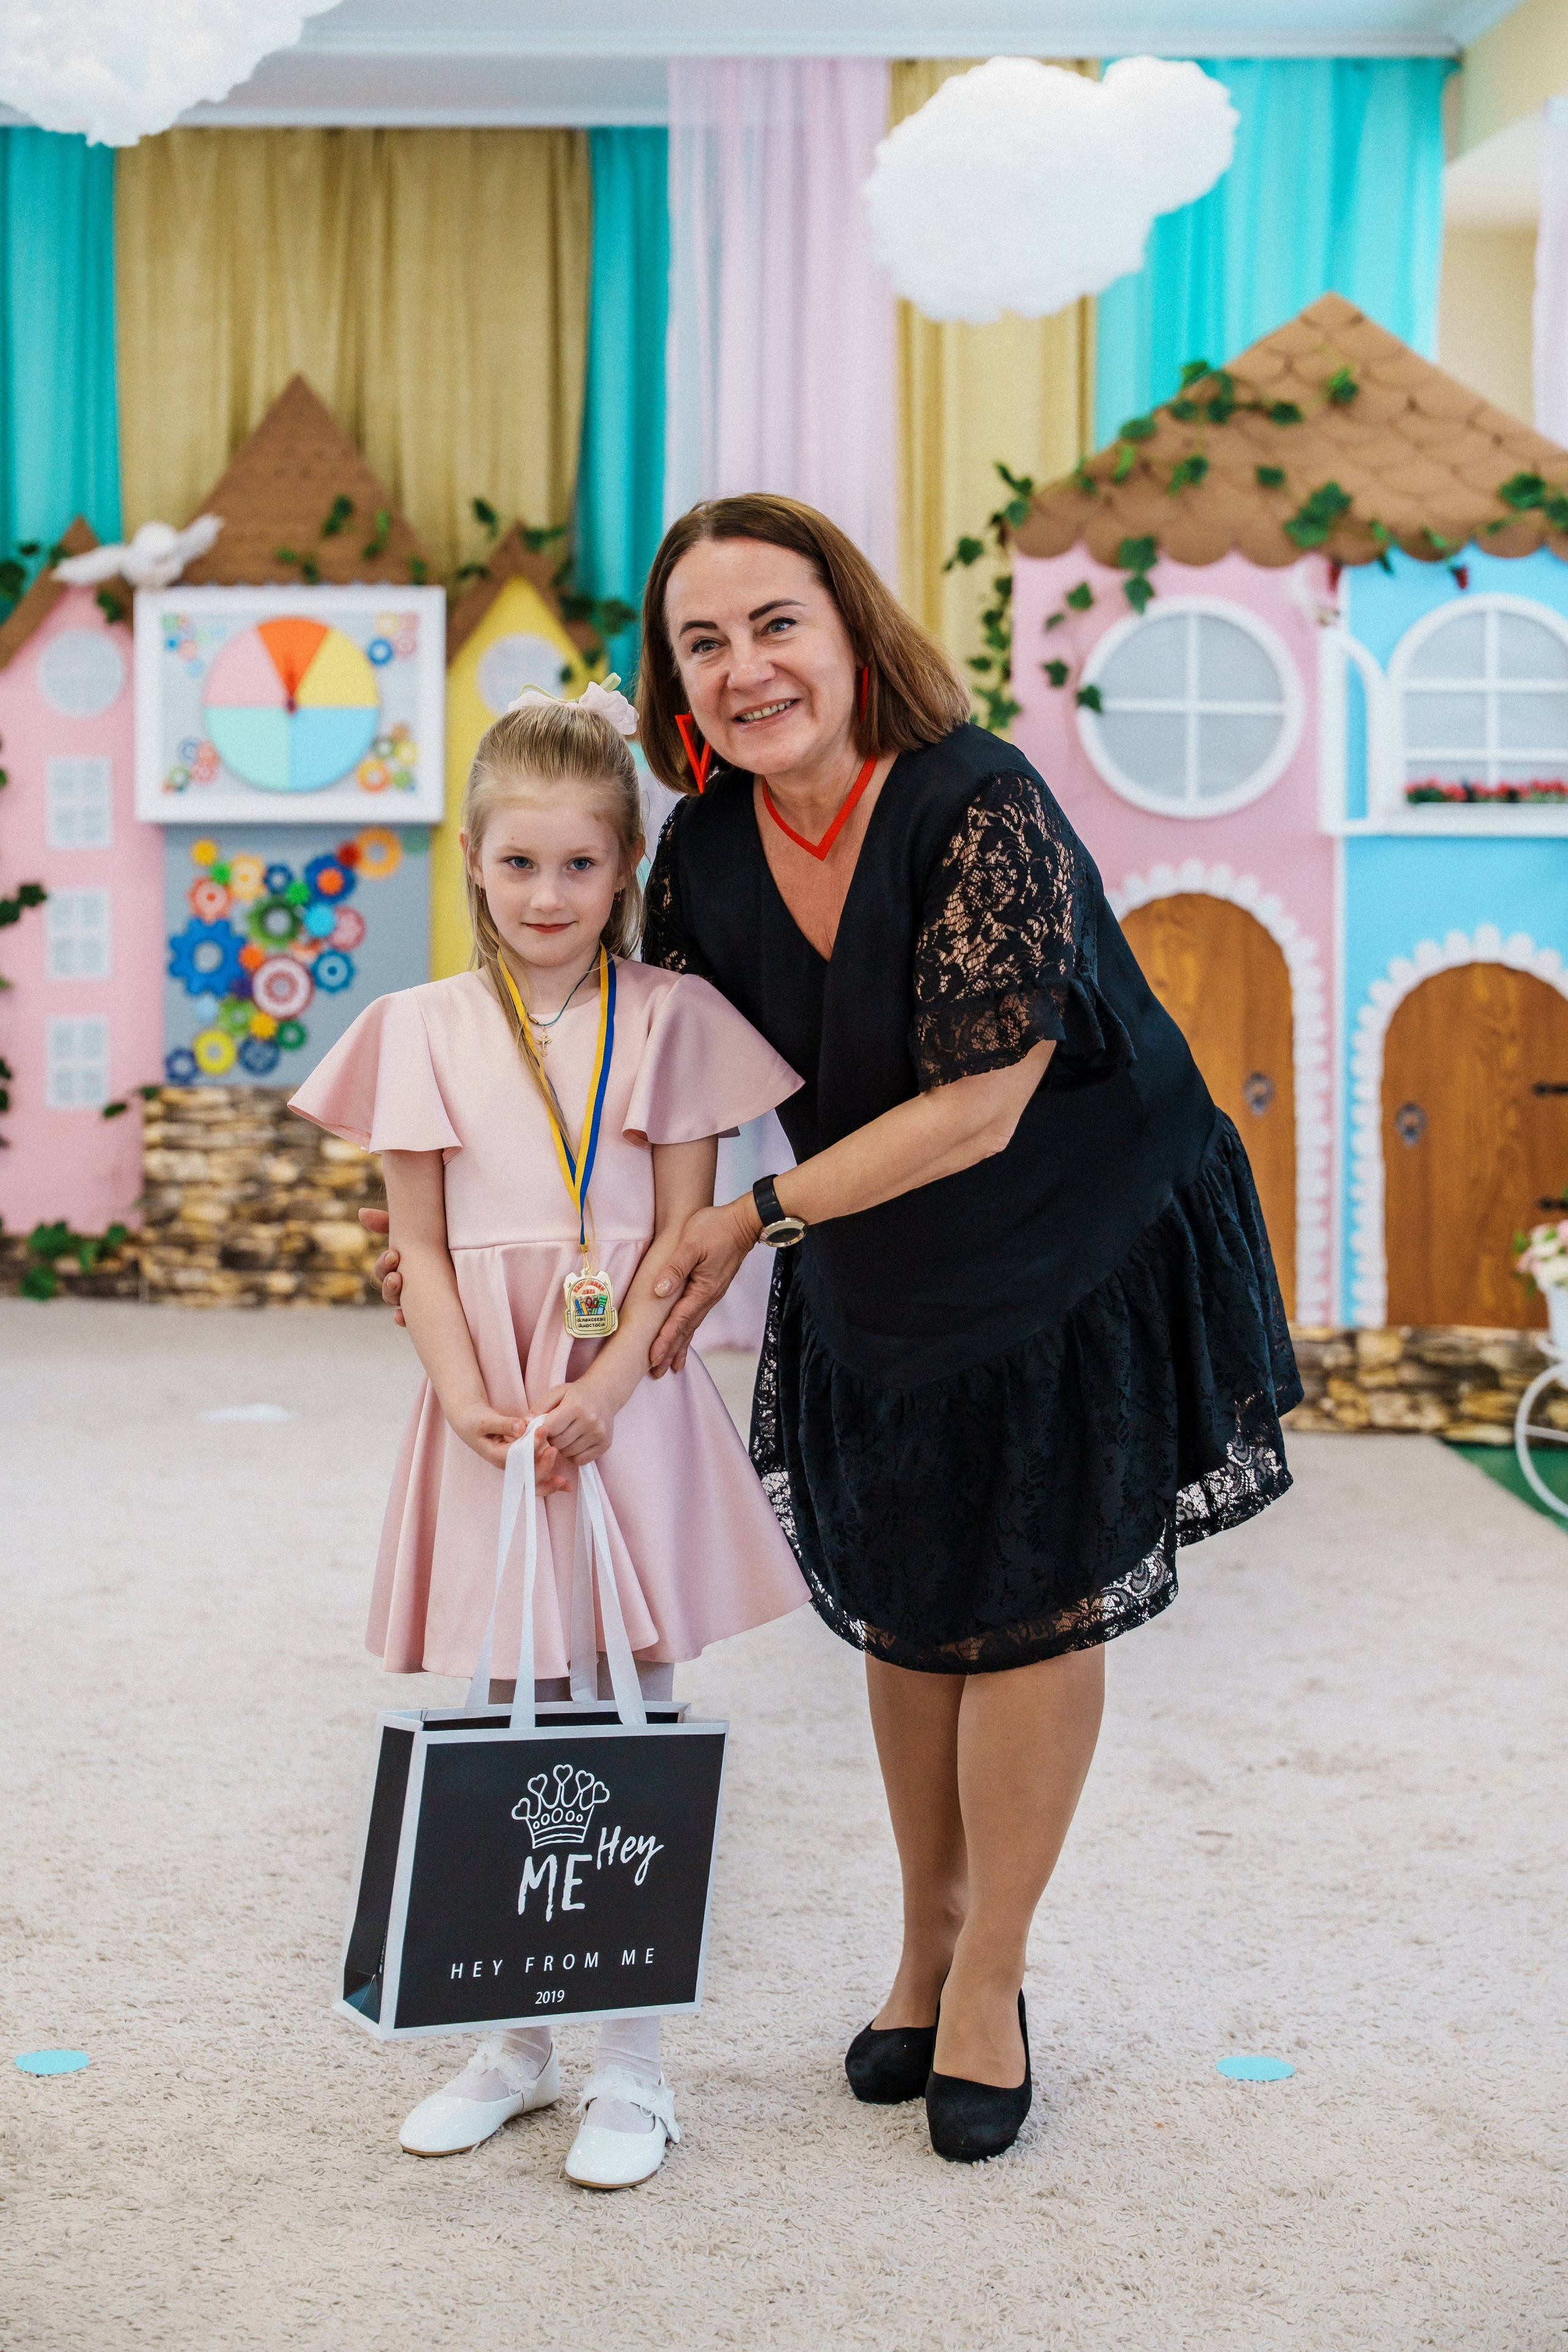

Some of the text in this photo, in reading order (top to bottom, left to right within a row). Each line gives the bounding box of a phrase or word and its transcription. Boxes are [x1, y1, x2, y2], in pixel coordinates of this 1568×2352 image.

[596, 1825, 664, 1886] Hey
[518, 1853, 593, 1922] ME
[450, 1948, 655, 1980] HEY FROM ME
[535, 1989, 565, 2005] 2019
